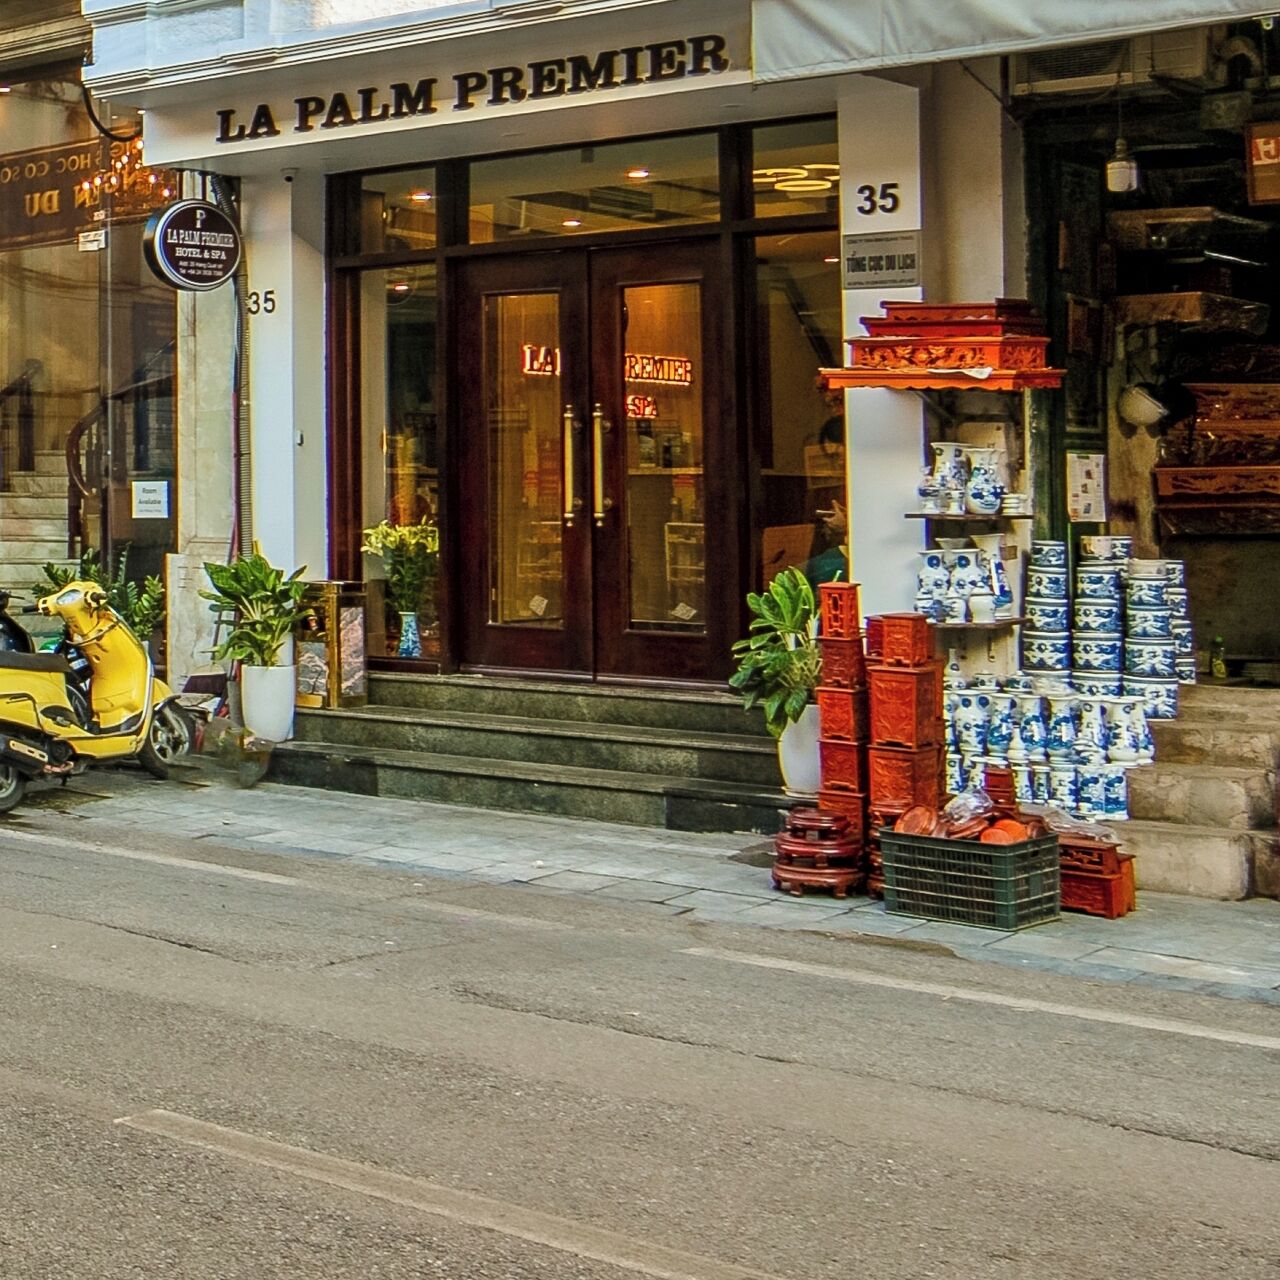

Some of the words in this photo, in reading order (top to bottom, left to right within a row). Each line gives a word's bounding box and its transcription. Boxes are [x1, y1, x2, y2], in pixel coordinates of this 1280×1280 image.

[216, 103, 280, 143] LA
[294, 78, 437, 132] PALM
[452, 35, 729, 111] PREMIER
[857, 183, 898, 215] 35
[167, 229, 178, 243] LA
[179, 230, 200, 245] PALM
[201, 231, 234, 247] PREMIER
[175, 247, 202, 258] HOTEL
[203, 249, 210, 259] &
[211, 249, 226, 260] SPA
[885, 255, 896, 270] DU
[247, 290, 275, 315] 35
[523, 345, 554, 375] LA
[624, 352, 693, 385] REMIER
